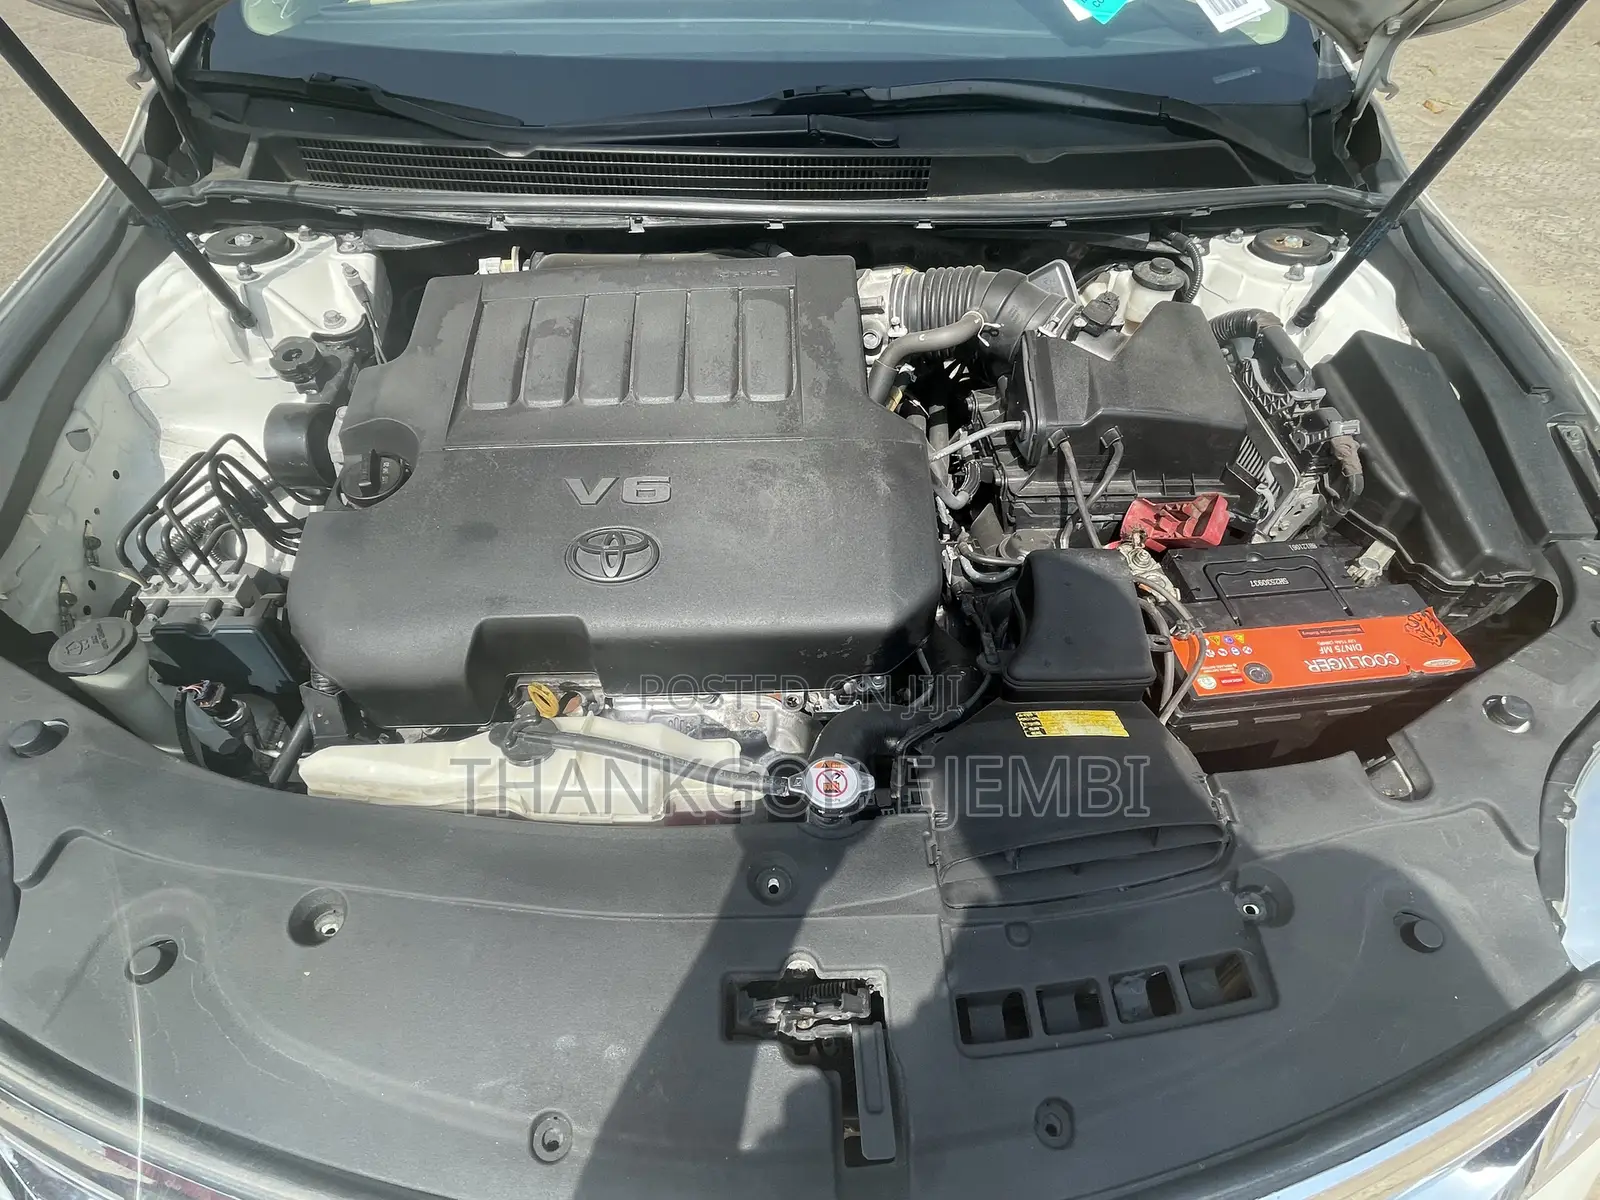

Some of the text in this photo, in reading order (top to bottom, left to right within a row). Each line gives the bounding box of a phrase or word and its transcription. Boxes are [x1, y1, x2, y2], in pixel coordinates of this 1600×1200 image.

[563, 475, 672, 506] V6
[1319, 642, 1363, 655] DIN75 MF
[1303, 651, 1400, 673] COOLTIGER
